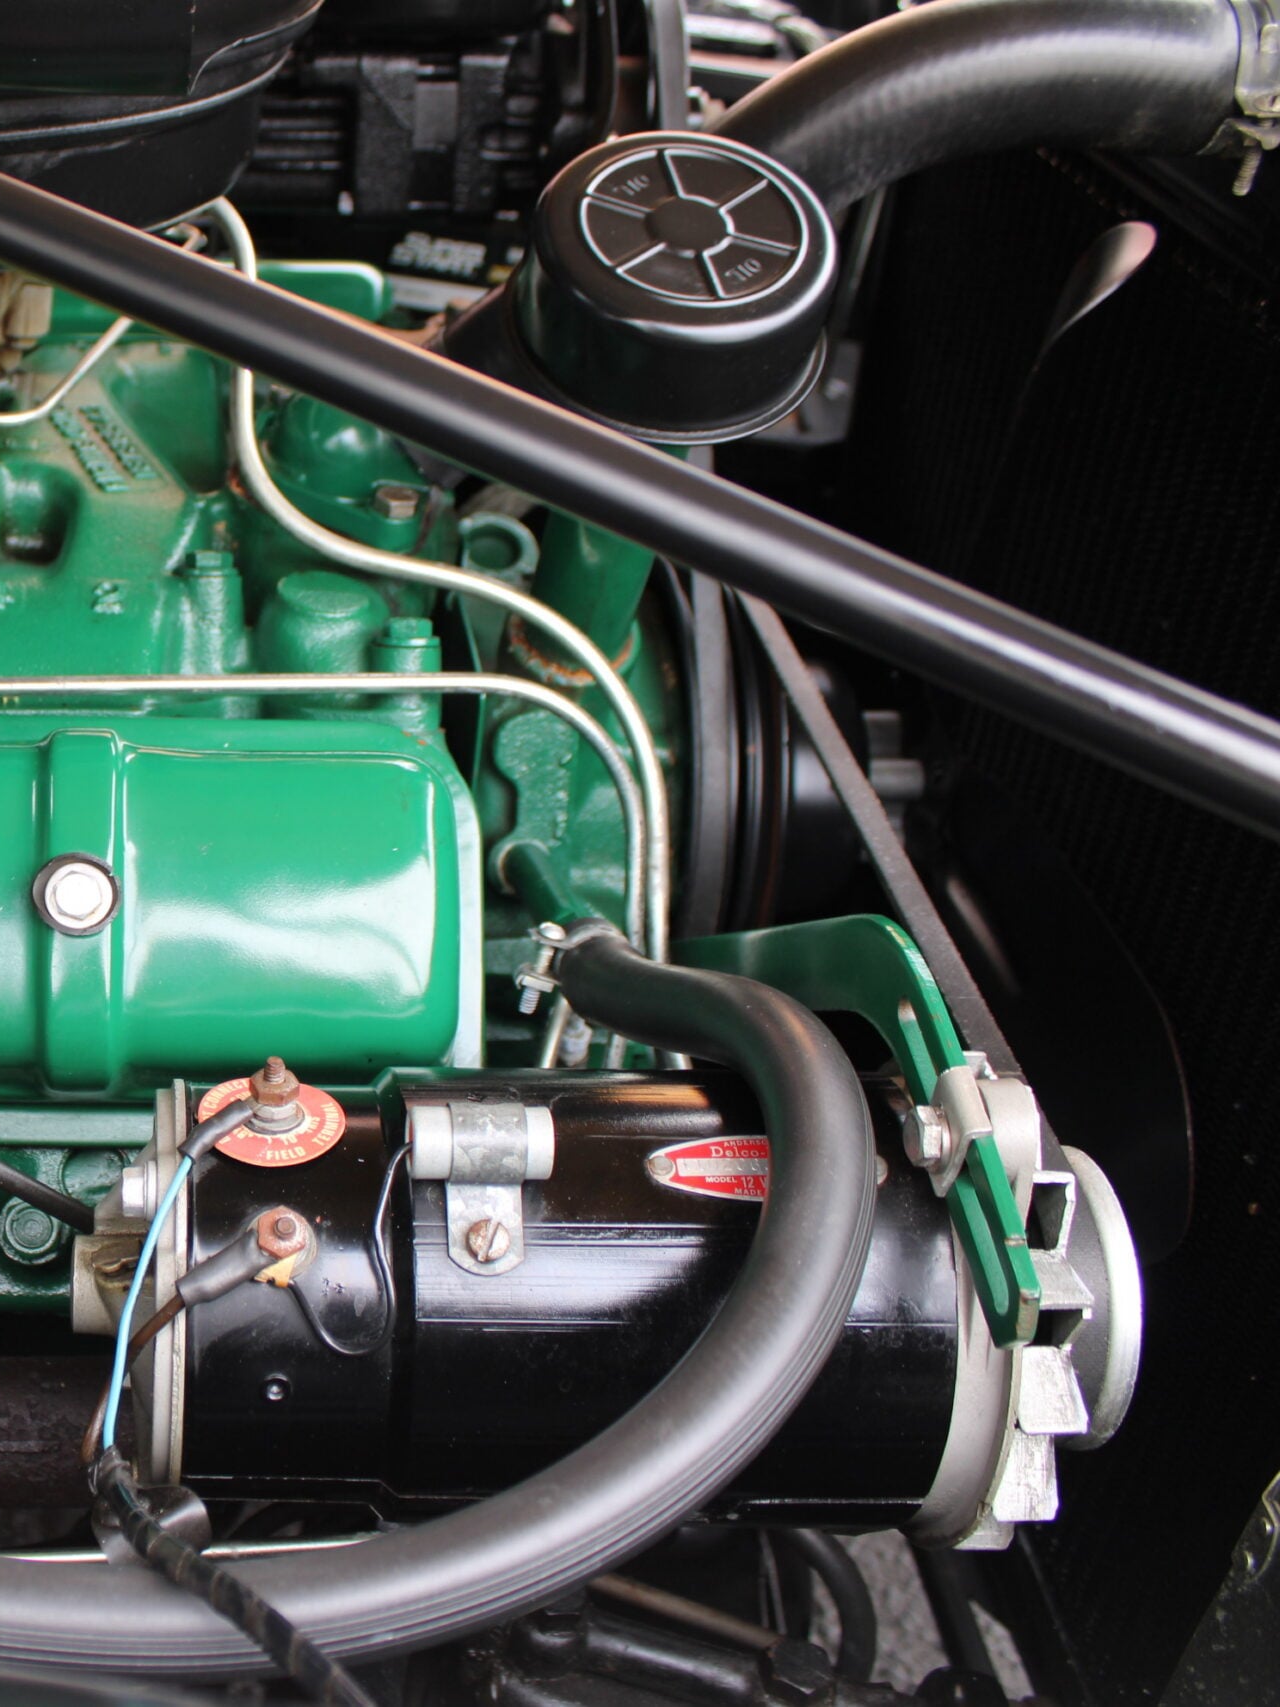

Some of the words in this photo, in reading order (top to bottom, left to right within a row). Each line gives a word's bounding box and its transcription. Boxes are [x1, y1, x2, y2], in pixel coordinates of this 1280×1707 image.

[612, 174, 650, 196] OIL
[724, 258, 761, 281] OIL
[266, 1146, 307, 1161] FIELD
[312, 1102, 339, 1146] TERMINAL
[705, 1176, 738, 1184] MODEL
[741, 1176, 756, 1189] 12
[734, 1188, 763, 1196] MADE
